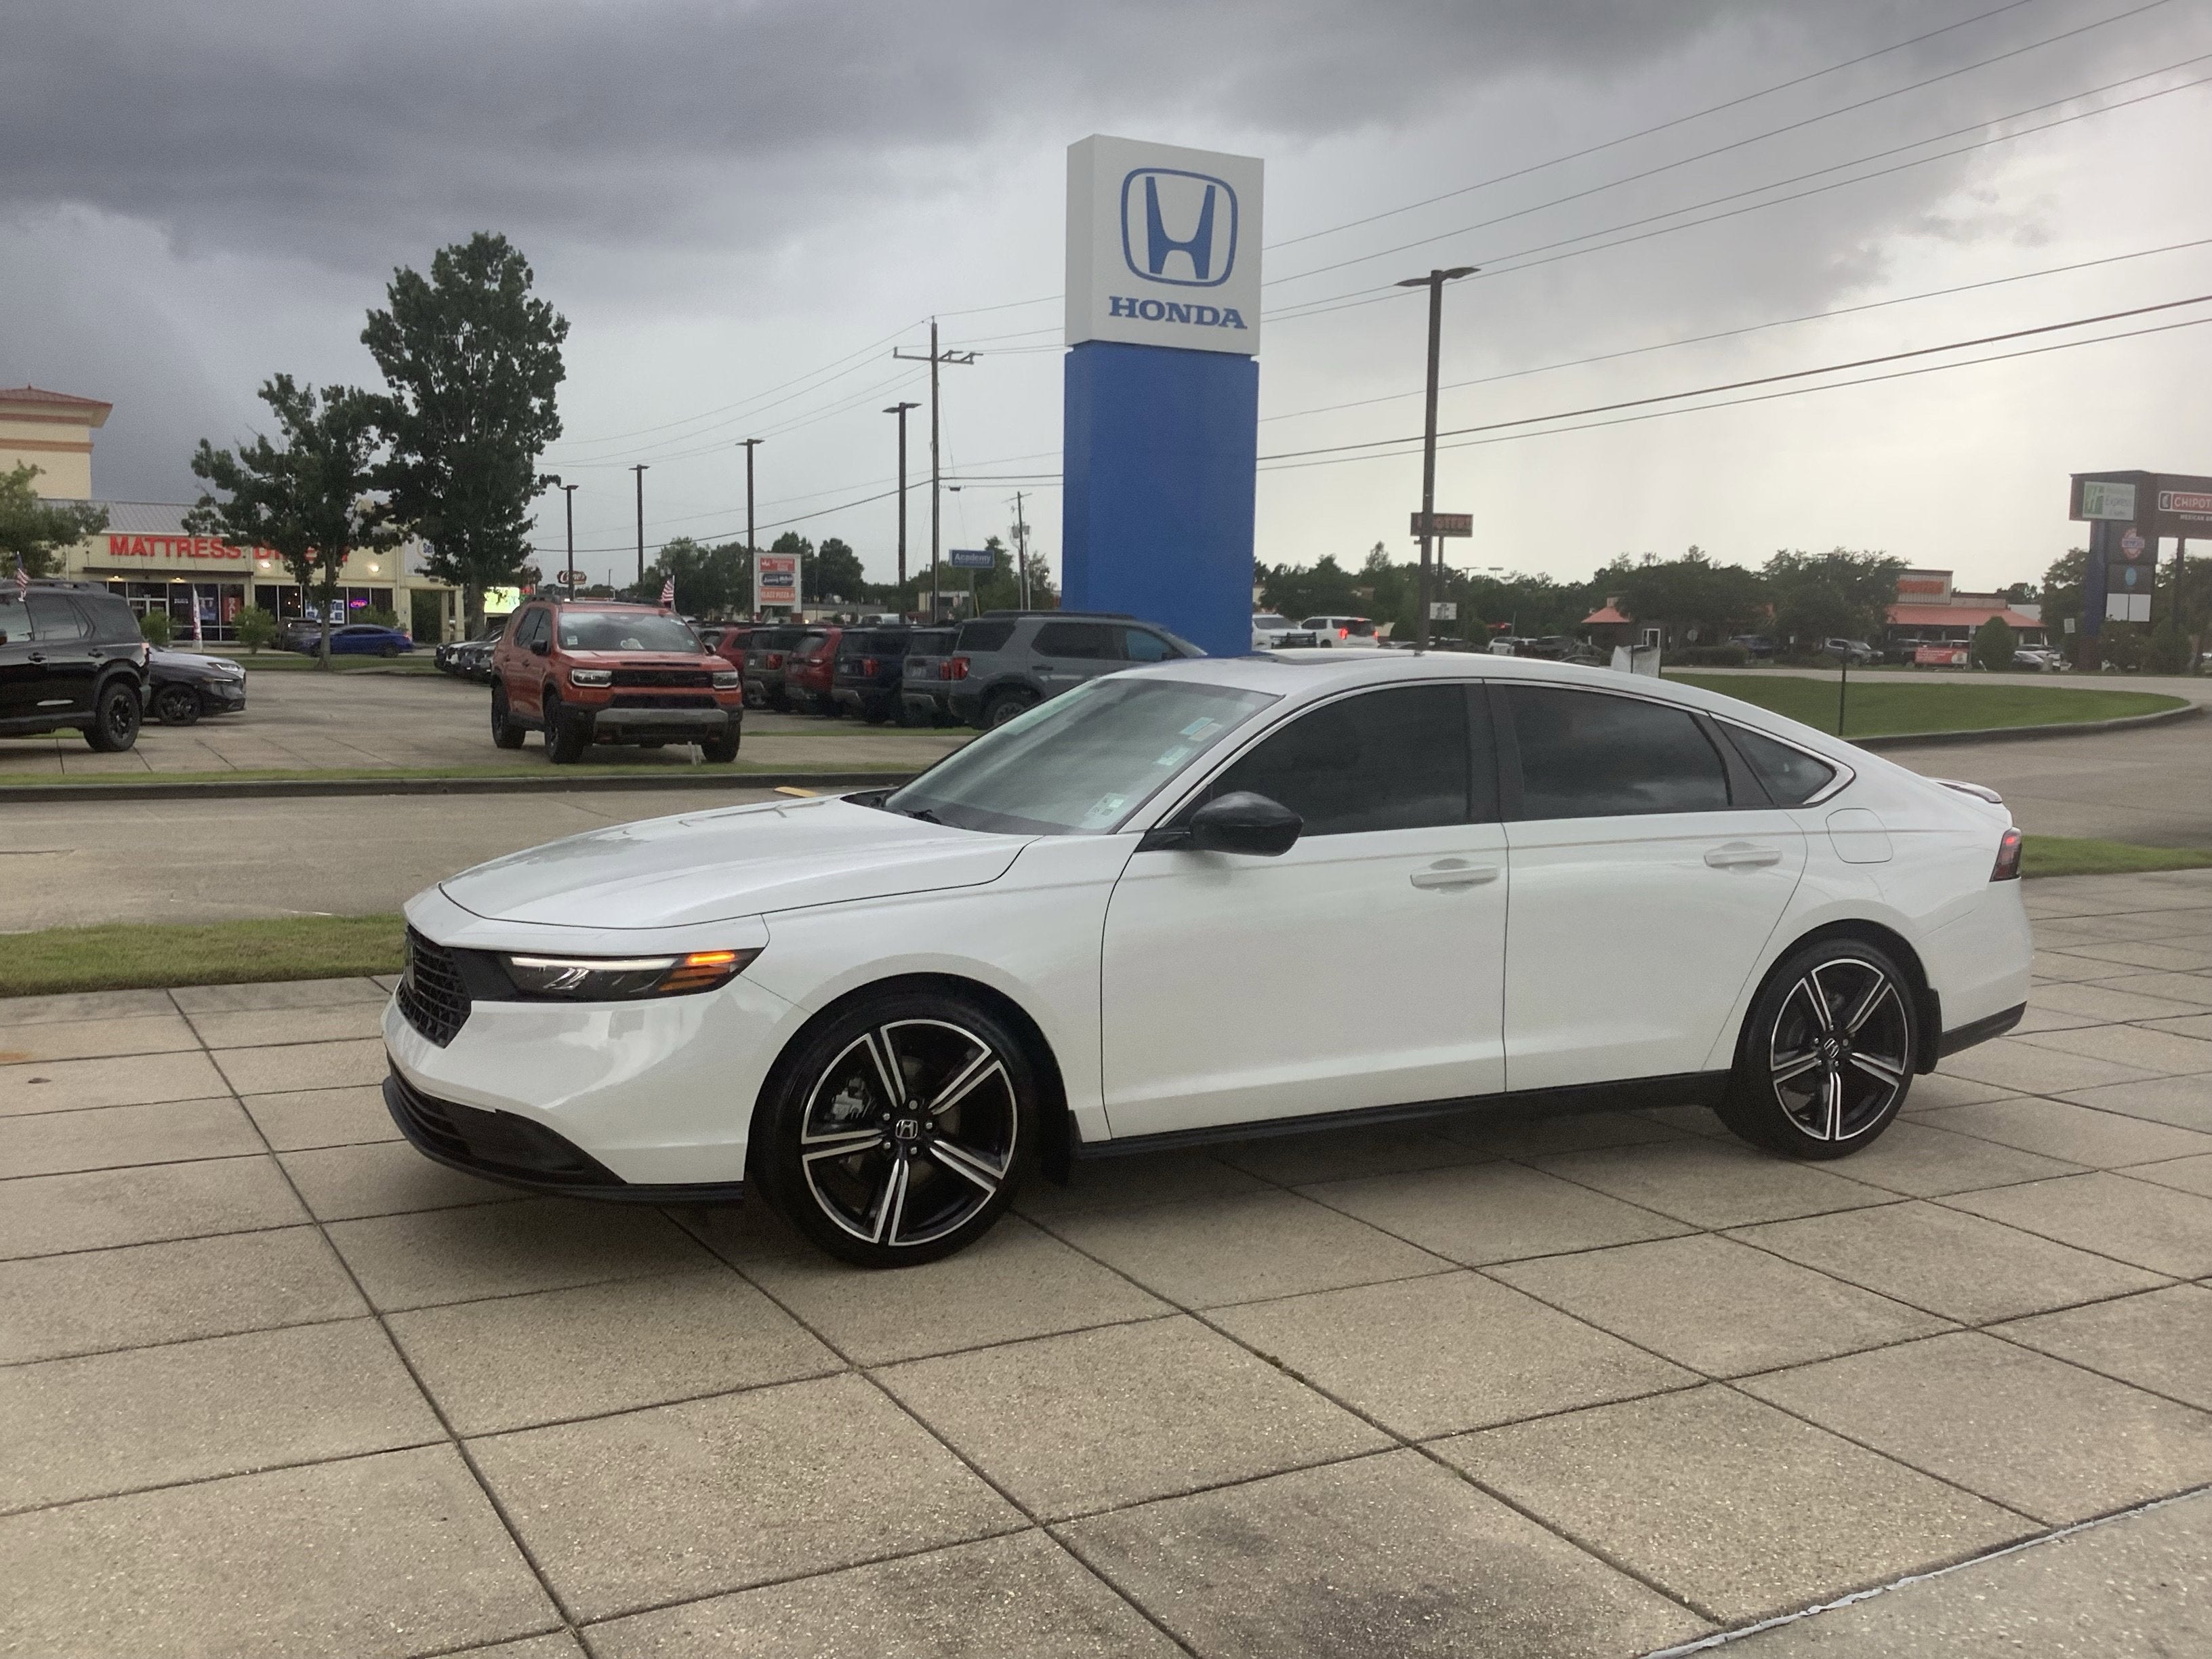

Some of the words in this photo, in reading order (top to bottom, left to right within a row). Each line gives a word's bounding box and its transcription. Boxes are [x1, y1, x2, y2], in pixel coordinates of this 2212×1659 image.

[1109, 295, 1248, 330] HONDA
[110, 535, 241, 559] MATTRESS
[954, 553, 991, 565] Academy
